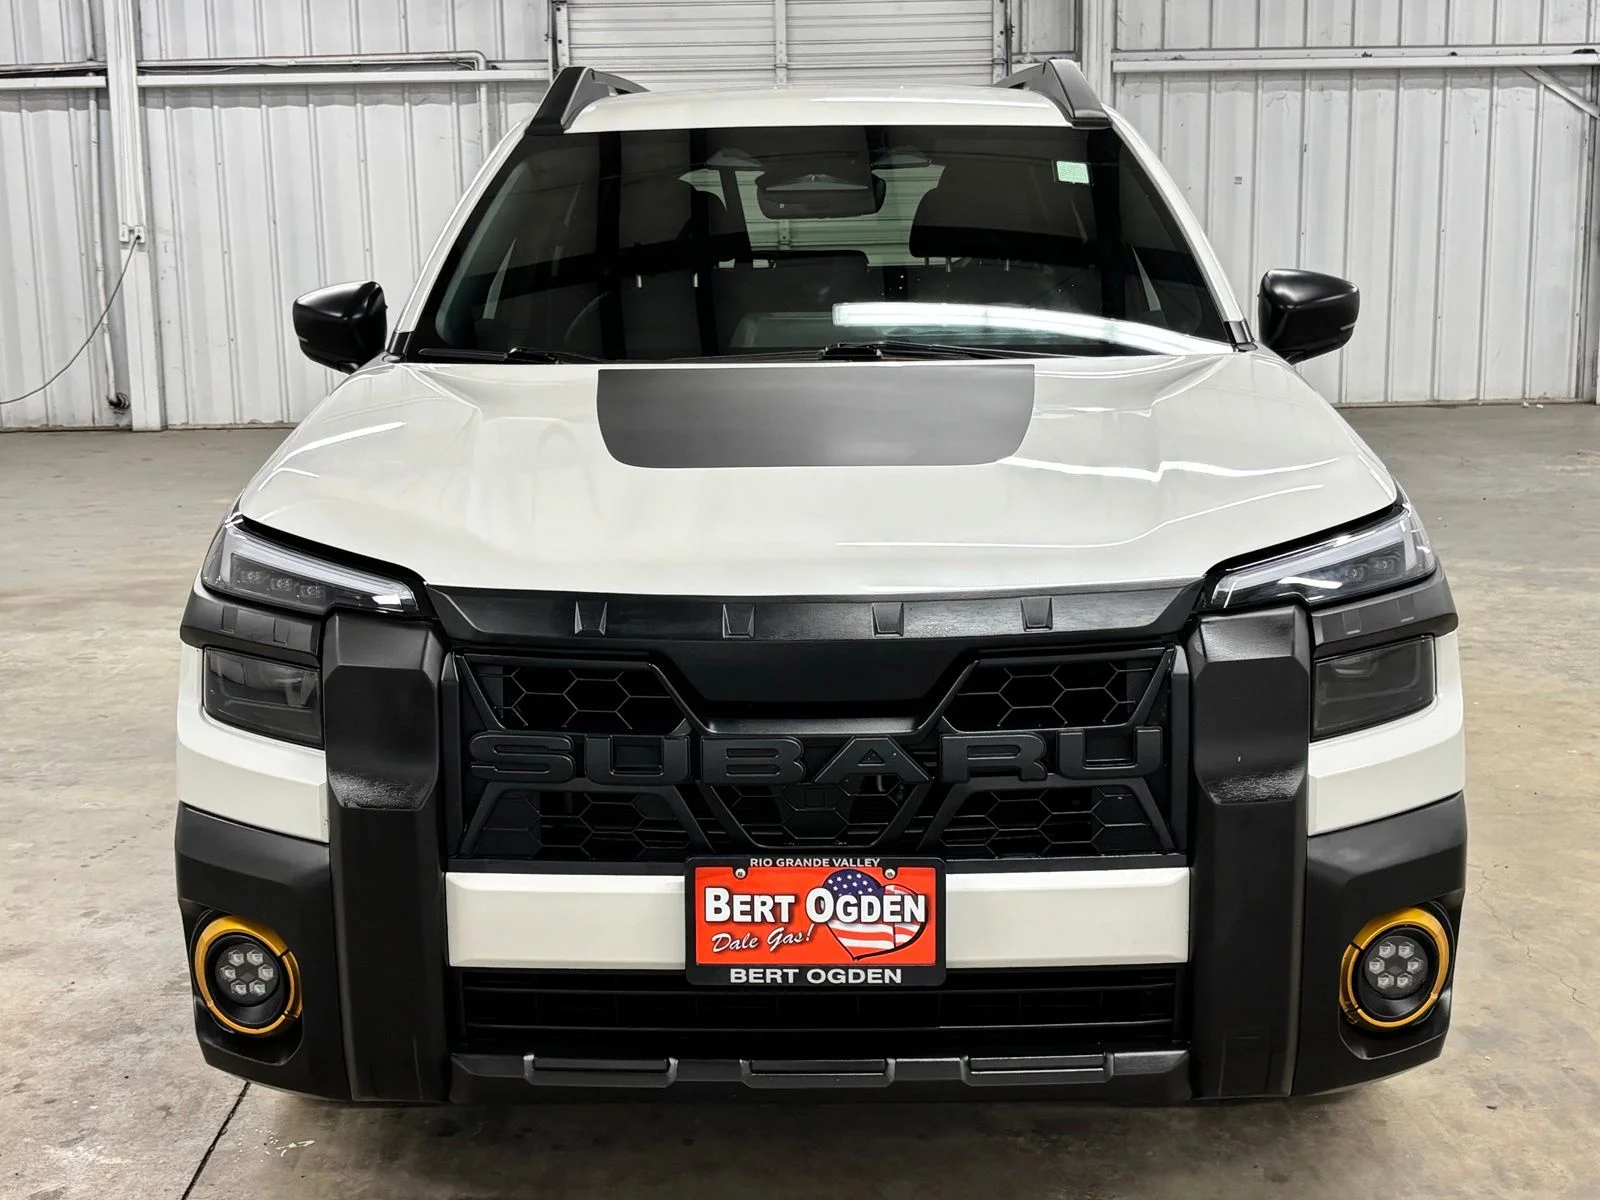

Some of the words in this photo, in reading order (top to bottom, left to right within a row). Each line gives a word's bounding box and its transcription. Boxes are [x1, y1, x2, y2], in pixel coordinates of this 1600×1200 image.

[469, 726, 1164, 786] SUBARU
[750, 858, 773, 867] RIO
[776, 858, 829, 868] GRANDE
[832, 858, 880, 867] VALLEY
[704, 887, 795, 923] BERT
[805, 886, 926, 923] OGDEN
[711, 932, 760, 953] Dale
[767, 924, 814, 952] Gas!
[730, 969, 799, 984] BERT
[806, 968, 902, 984] OGDEN
